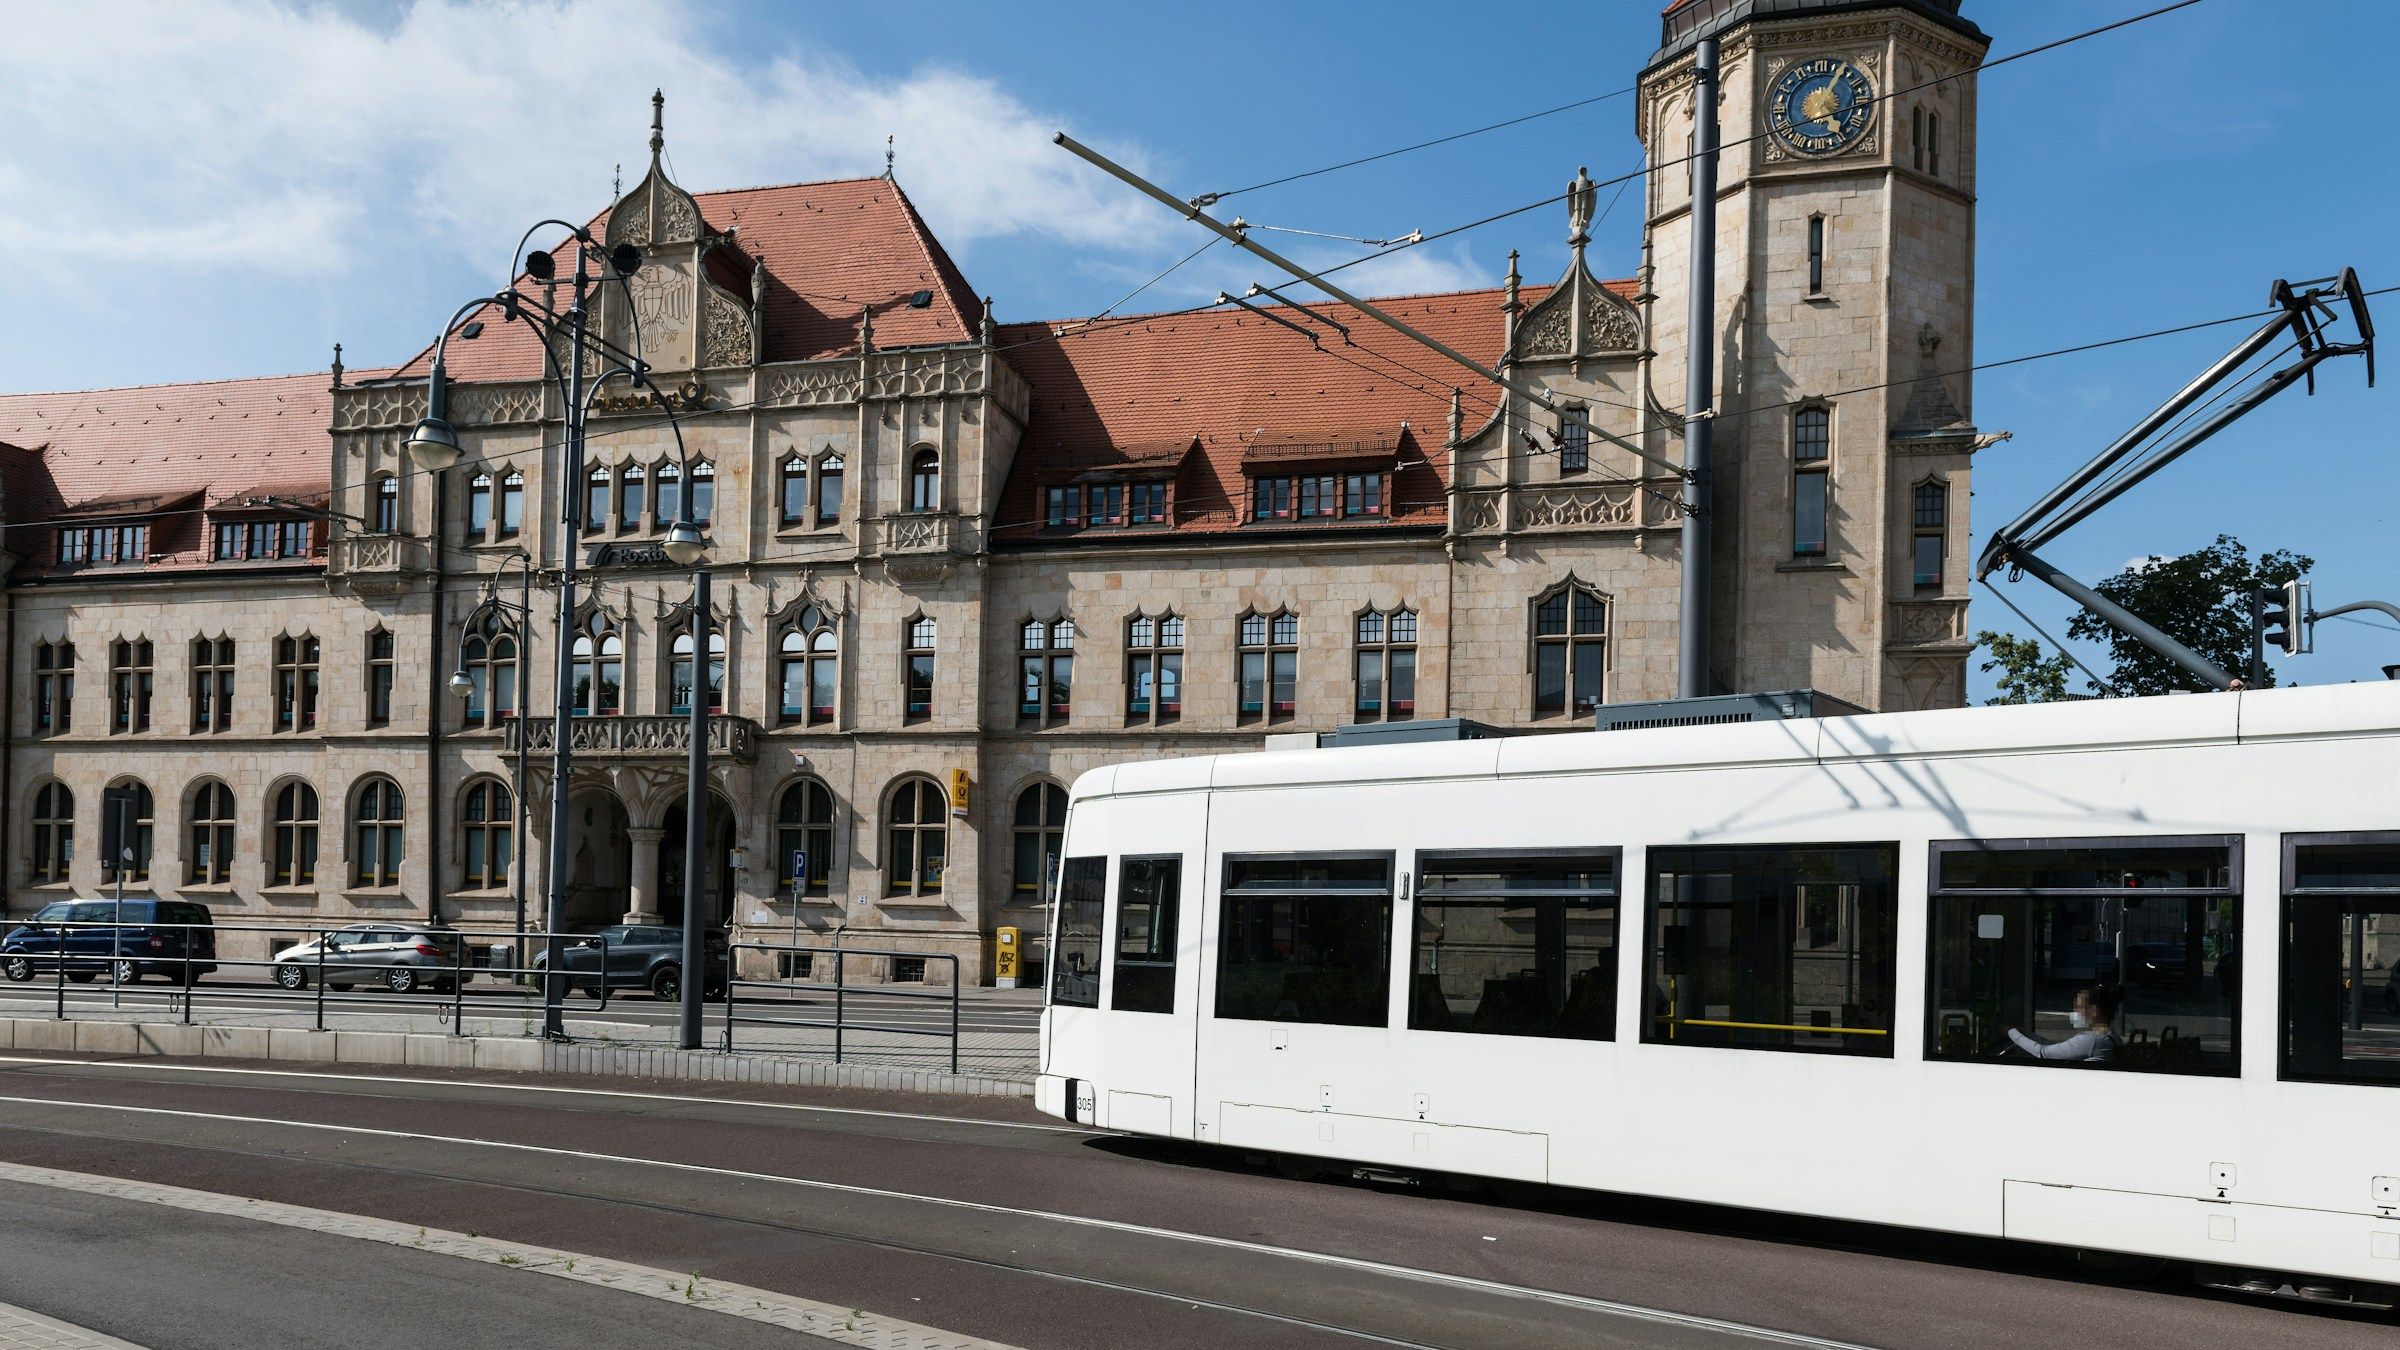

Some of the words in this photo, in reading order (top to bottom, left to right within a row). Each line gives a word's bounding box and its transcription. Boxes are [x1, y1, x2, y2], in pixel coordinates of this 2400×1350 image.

[619, 546, 670, 562] Postb
[795, 854, 804, 875] P
[1077, 1097, 1092, 1111] 305
